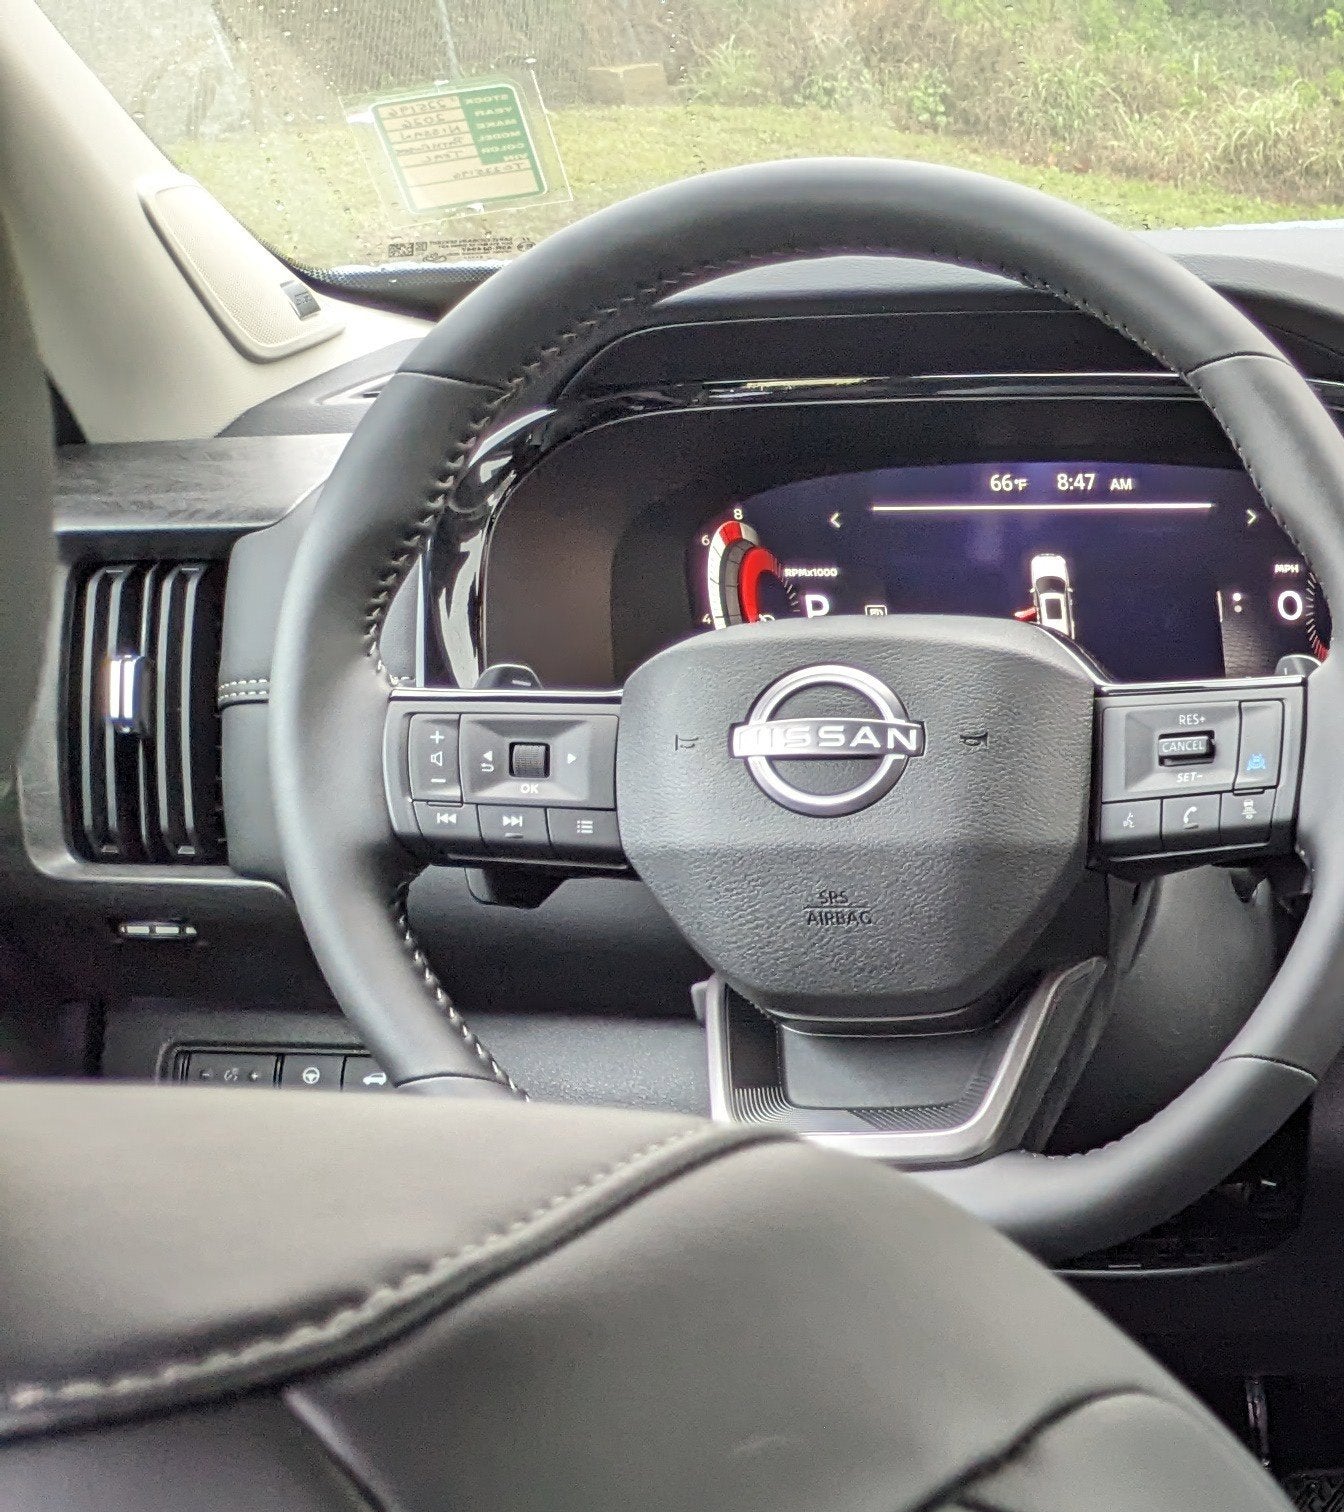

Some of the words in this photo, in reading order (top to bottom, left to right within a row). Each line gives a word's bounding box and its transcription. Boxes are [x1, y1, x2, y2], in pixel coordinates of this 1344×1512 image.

[1056, 473, 1096, 491] 8:47
[1109, 478, 1133, 491] AM
[733, 508, 744, 521] 8
[701, 534, 711, 546] 6
[1274, 563, 1300, 574] MPH
[805, 594, 830, 619] P
[738, 725, 917, 751] NISSAN
[1162, 740, 1205, 753] CANCEL
[519, 783, 539, 794] OK
